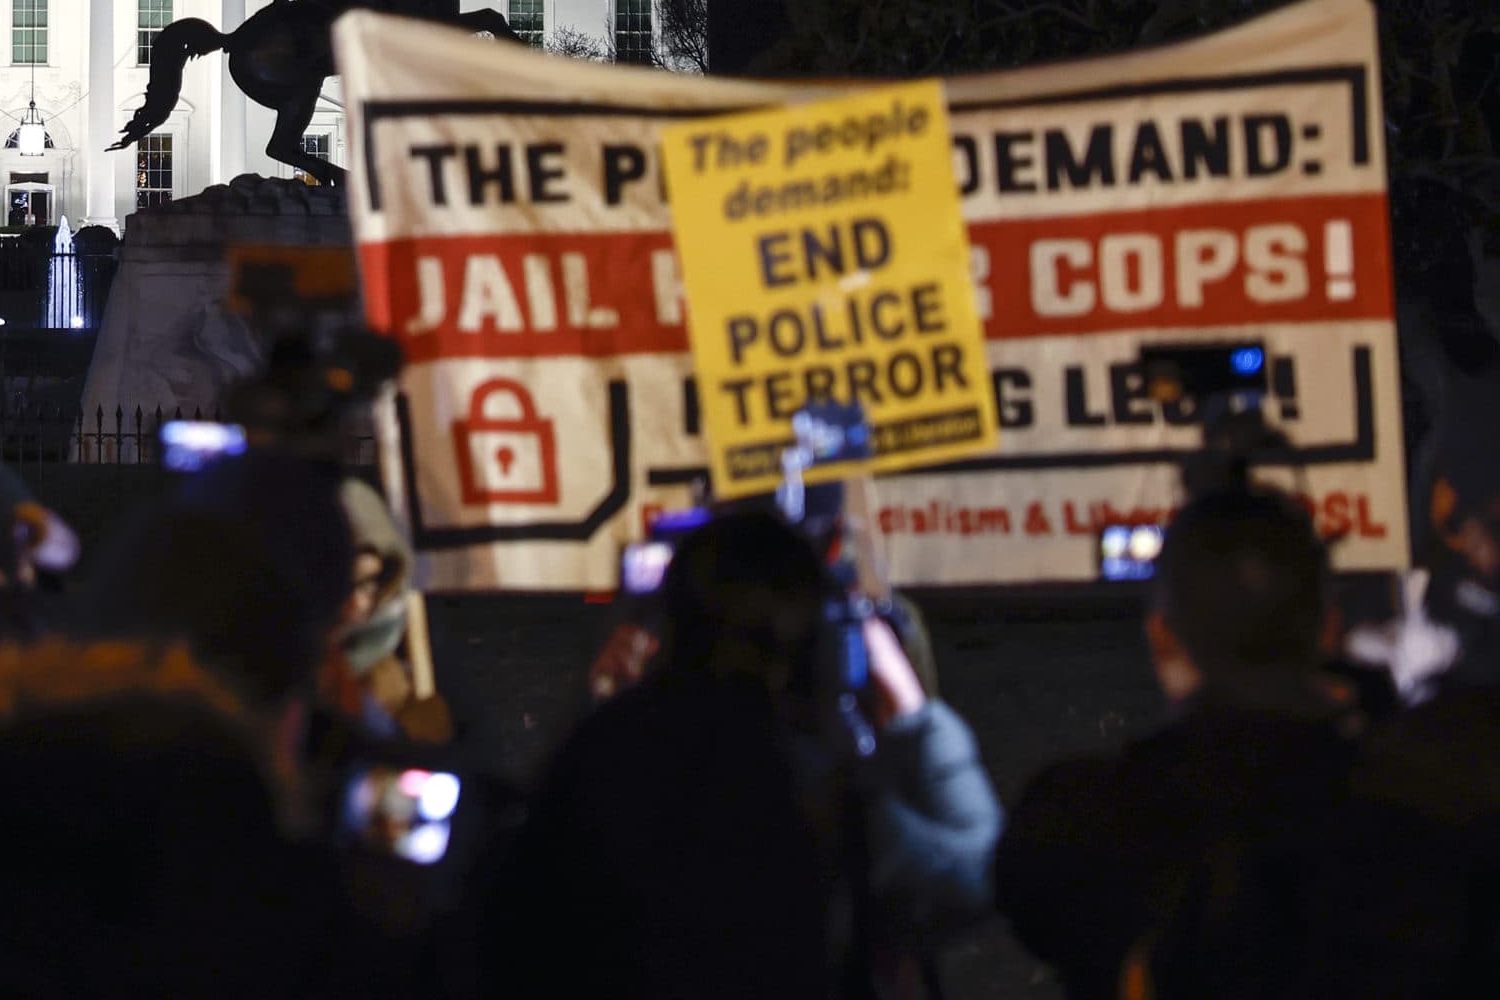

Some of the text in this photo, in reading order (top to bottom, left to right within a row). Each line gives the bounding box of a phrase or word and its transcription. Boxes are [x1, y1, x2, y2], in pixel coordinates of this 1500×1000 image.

[689, 97, 929, 173] The people
[408, 141, 572, 207] THE
[723, 155, 911, 221] demand:
[757, 216, 894, 289] END
[1028, 218, 1356, 319] COPS!
[405, 251, 620, 336] JAIL
[726, 282, 948, 366] POLICE
[719, 343, 969, 426] TERROR
[876, 500, 1011, 536] cialism
[1022, 500, 1053, 537] &
